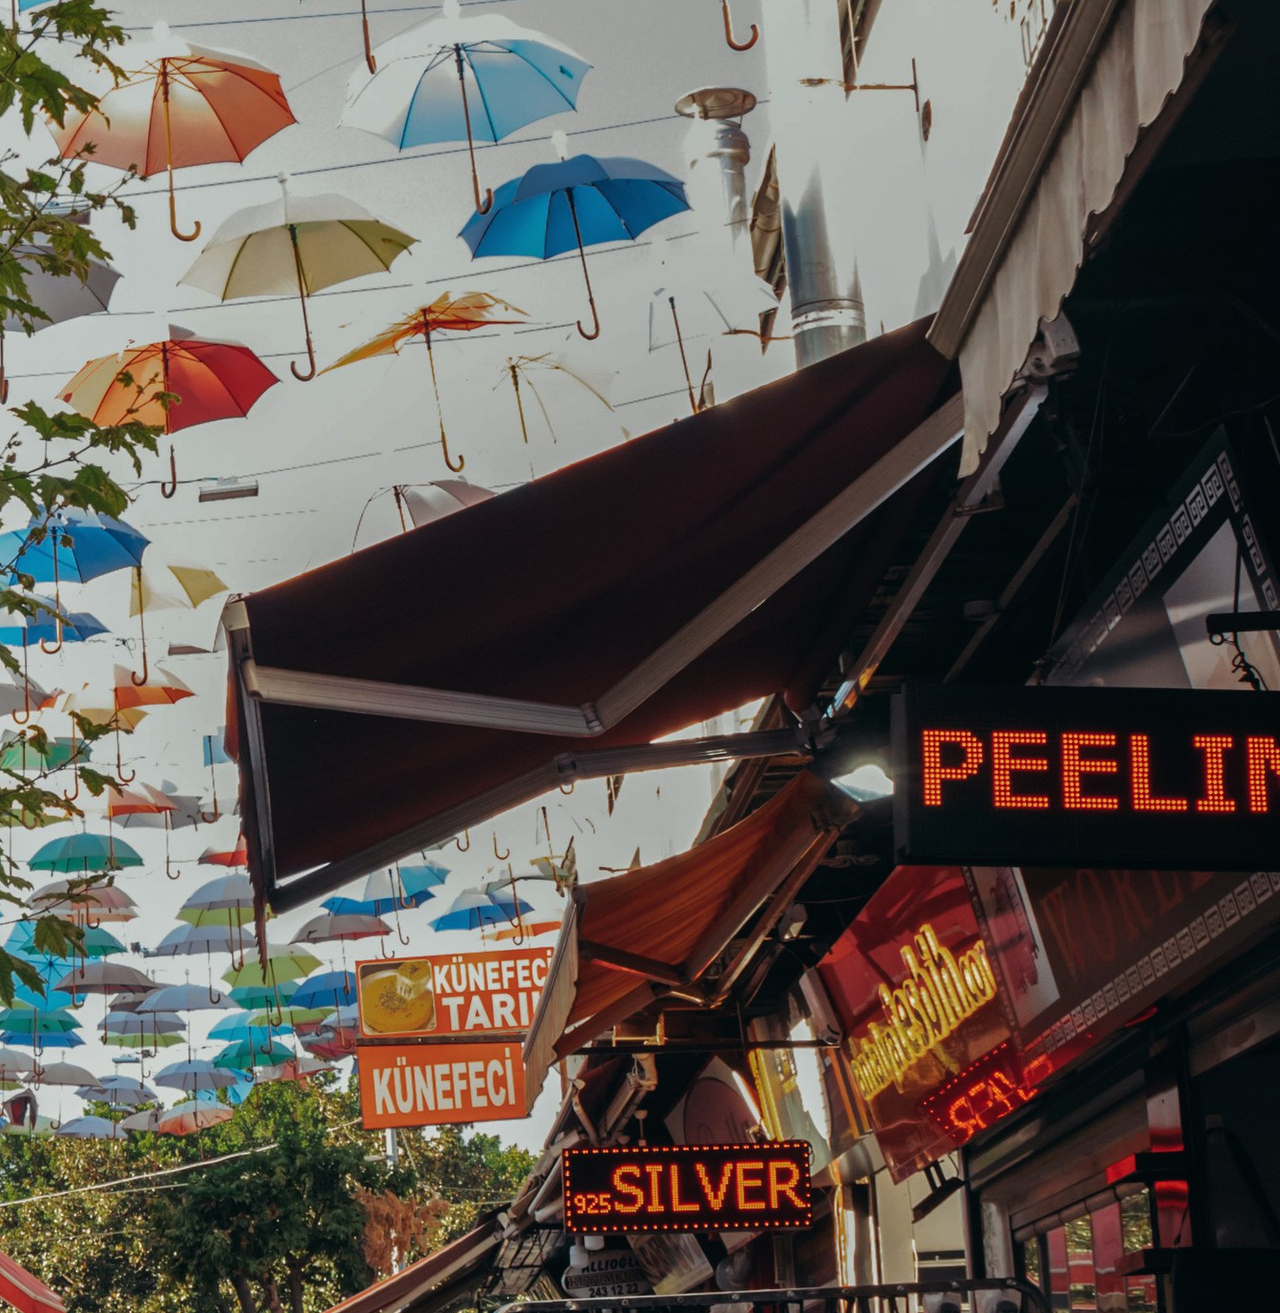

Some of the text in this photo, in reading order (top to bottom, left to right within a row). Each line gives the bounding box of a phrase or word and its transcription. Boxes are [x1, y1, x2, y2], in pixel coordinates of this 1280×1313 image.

[372, 1047, 516, 1115] KÜNEFECİ
[574, 1161, 807, 1214] 925 SILVER
[589, 1283, 639, 1298] 243 12 22
